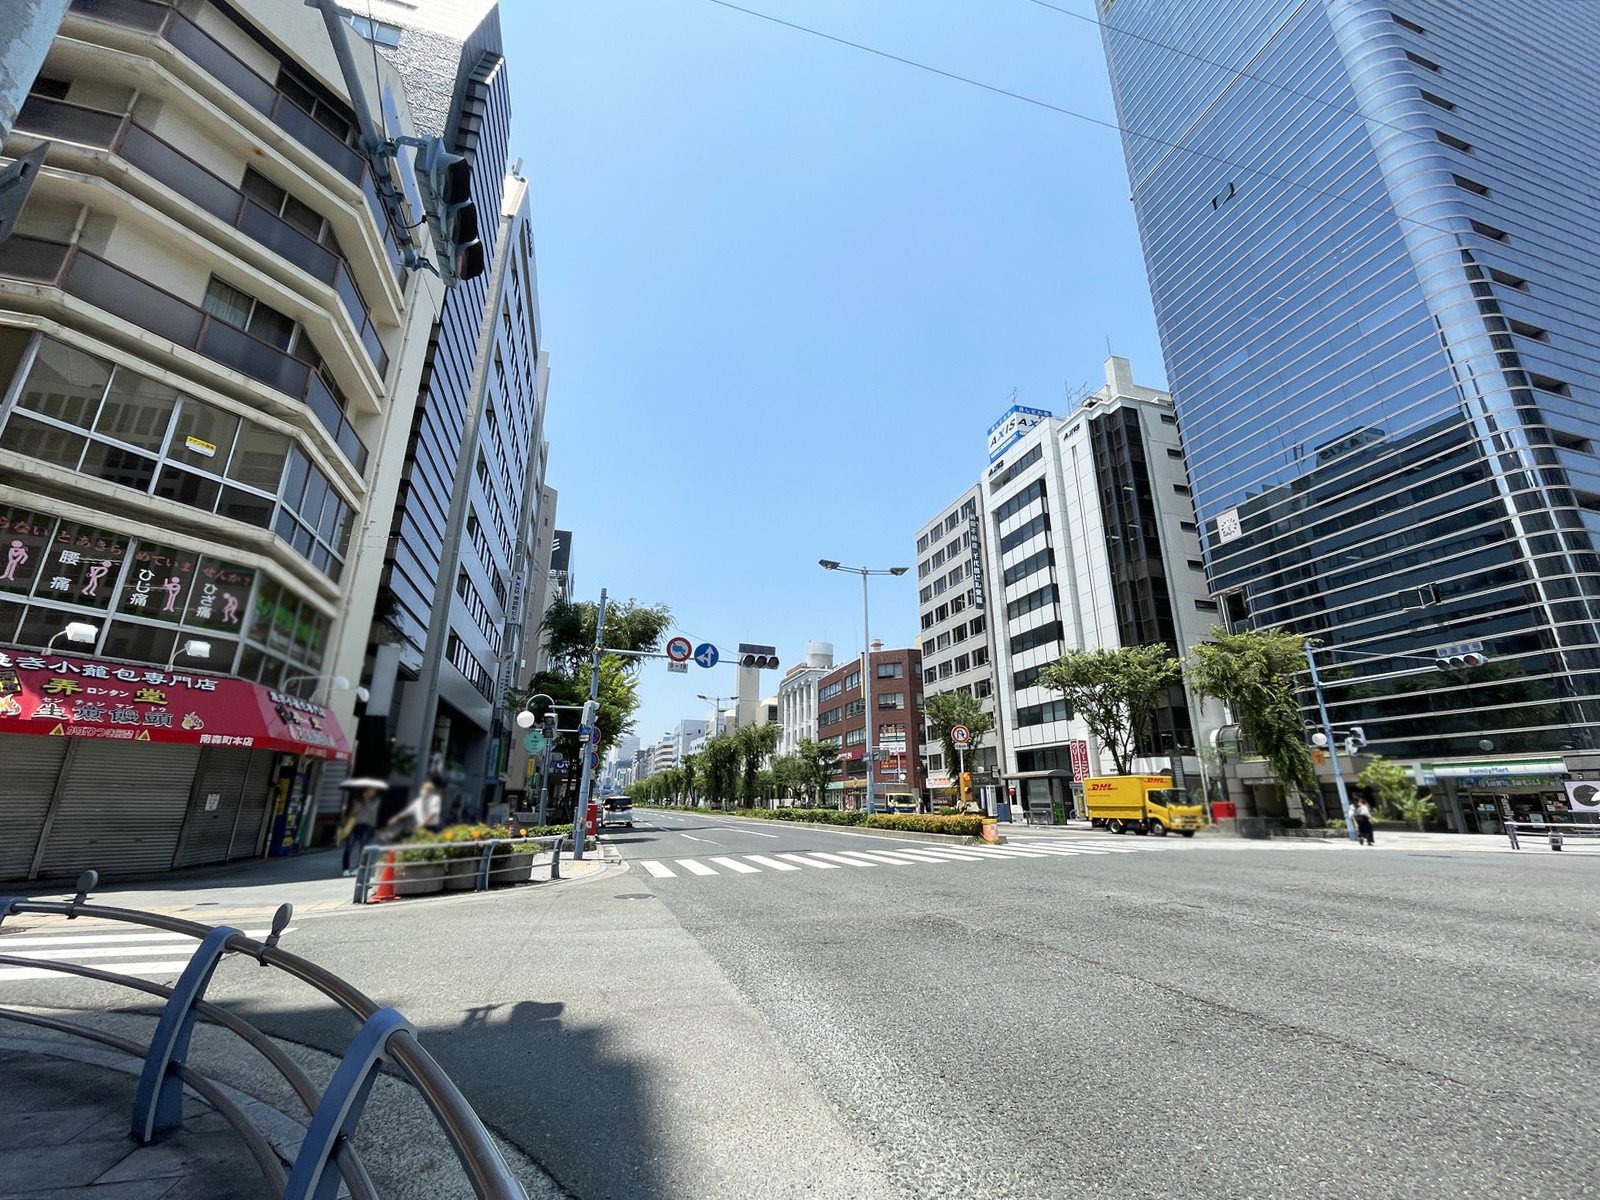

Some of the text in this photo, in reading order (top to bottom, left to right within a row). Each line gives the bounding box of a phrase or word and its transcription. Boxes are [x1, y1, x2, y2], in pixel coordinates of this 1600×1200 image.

[989, 418, 1016, 448] AXIS
[129, 568, 156, 608] ひじ痛
[195, 583, 219, 620] ひざ痛
[86, 687, 130, 698] ロンタン
[199, 733, 254, 748] 南森町本店
[1070, 742, 1082, 781] クリーニング
[1469, 766, 1510, 775] FamilyMart
[1091, 783, 1113, 791] DHL
